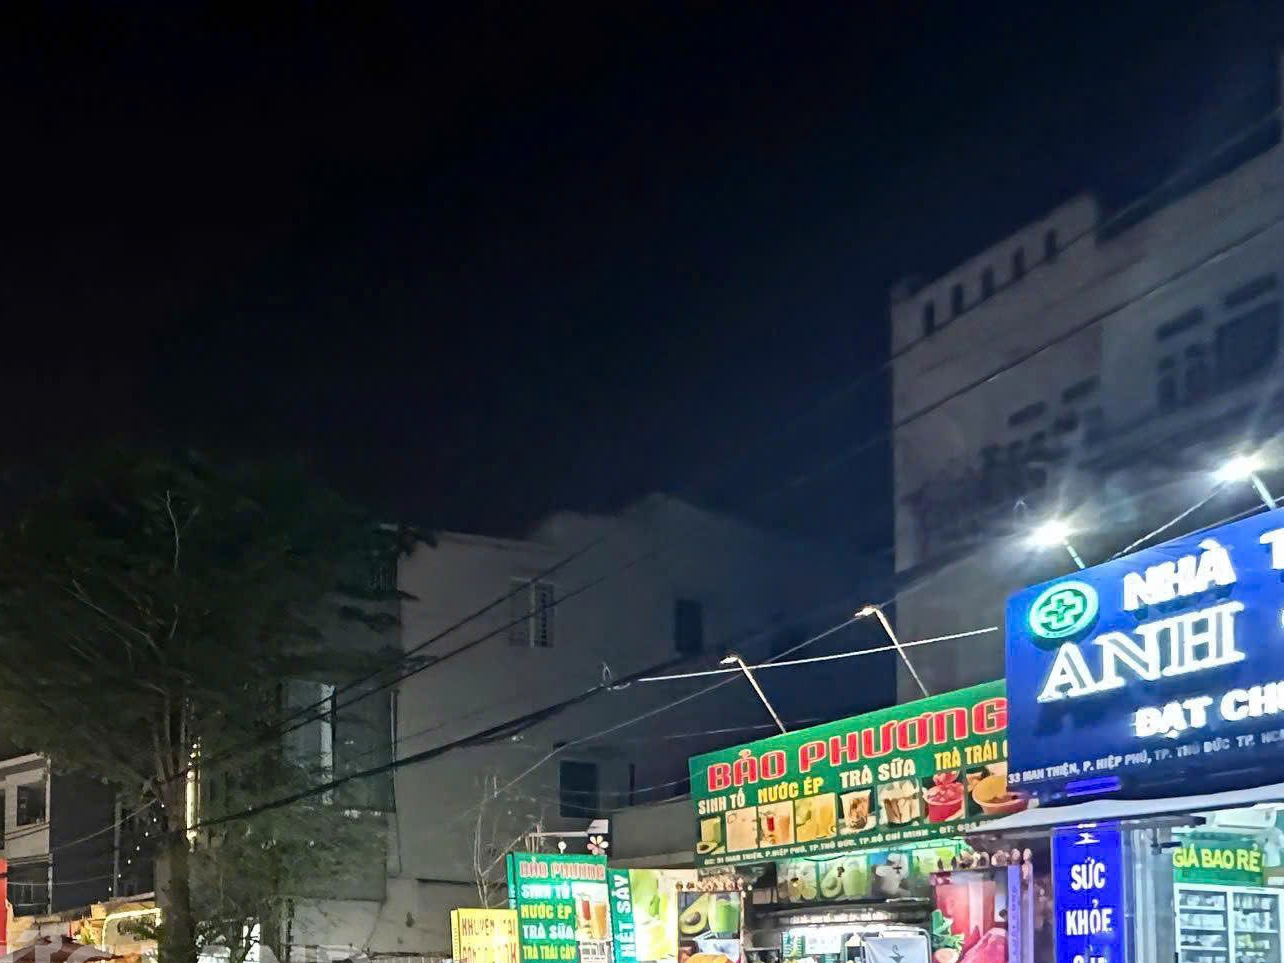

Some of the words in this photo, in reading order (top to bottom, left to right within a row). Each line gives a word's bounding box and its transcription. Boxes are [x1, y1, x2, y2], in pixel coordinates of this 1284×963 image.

[1124, 538, 1237, 611] NHÀ
[1037, 601, 1245, 703] ANH
[1132, 696, 1213, 738] ĐẠT
[698, 796, 726, 815] SINH
[758, 781, 799, 804] NƯỚC
[804, 776, 824, 796] ÉP
[839, 765, 873, 788] TRÀ
[878, 757, 916, 781] SỮA
[934, 747, 961, 770] TRÀ
[965, 740, 998, 765] TRÁI
[707, 749, 787, 792] BẢO
[1070, 856, 1106, 891] SỨC
[1172, 843, 1200, 868] GIÁ
[522, 922, 546, 939] TRÀ
[1065, 899, 1113, 937] KHỎE
